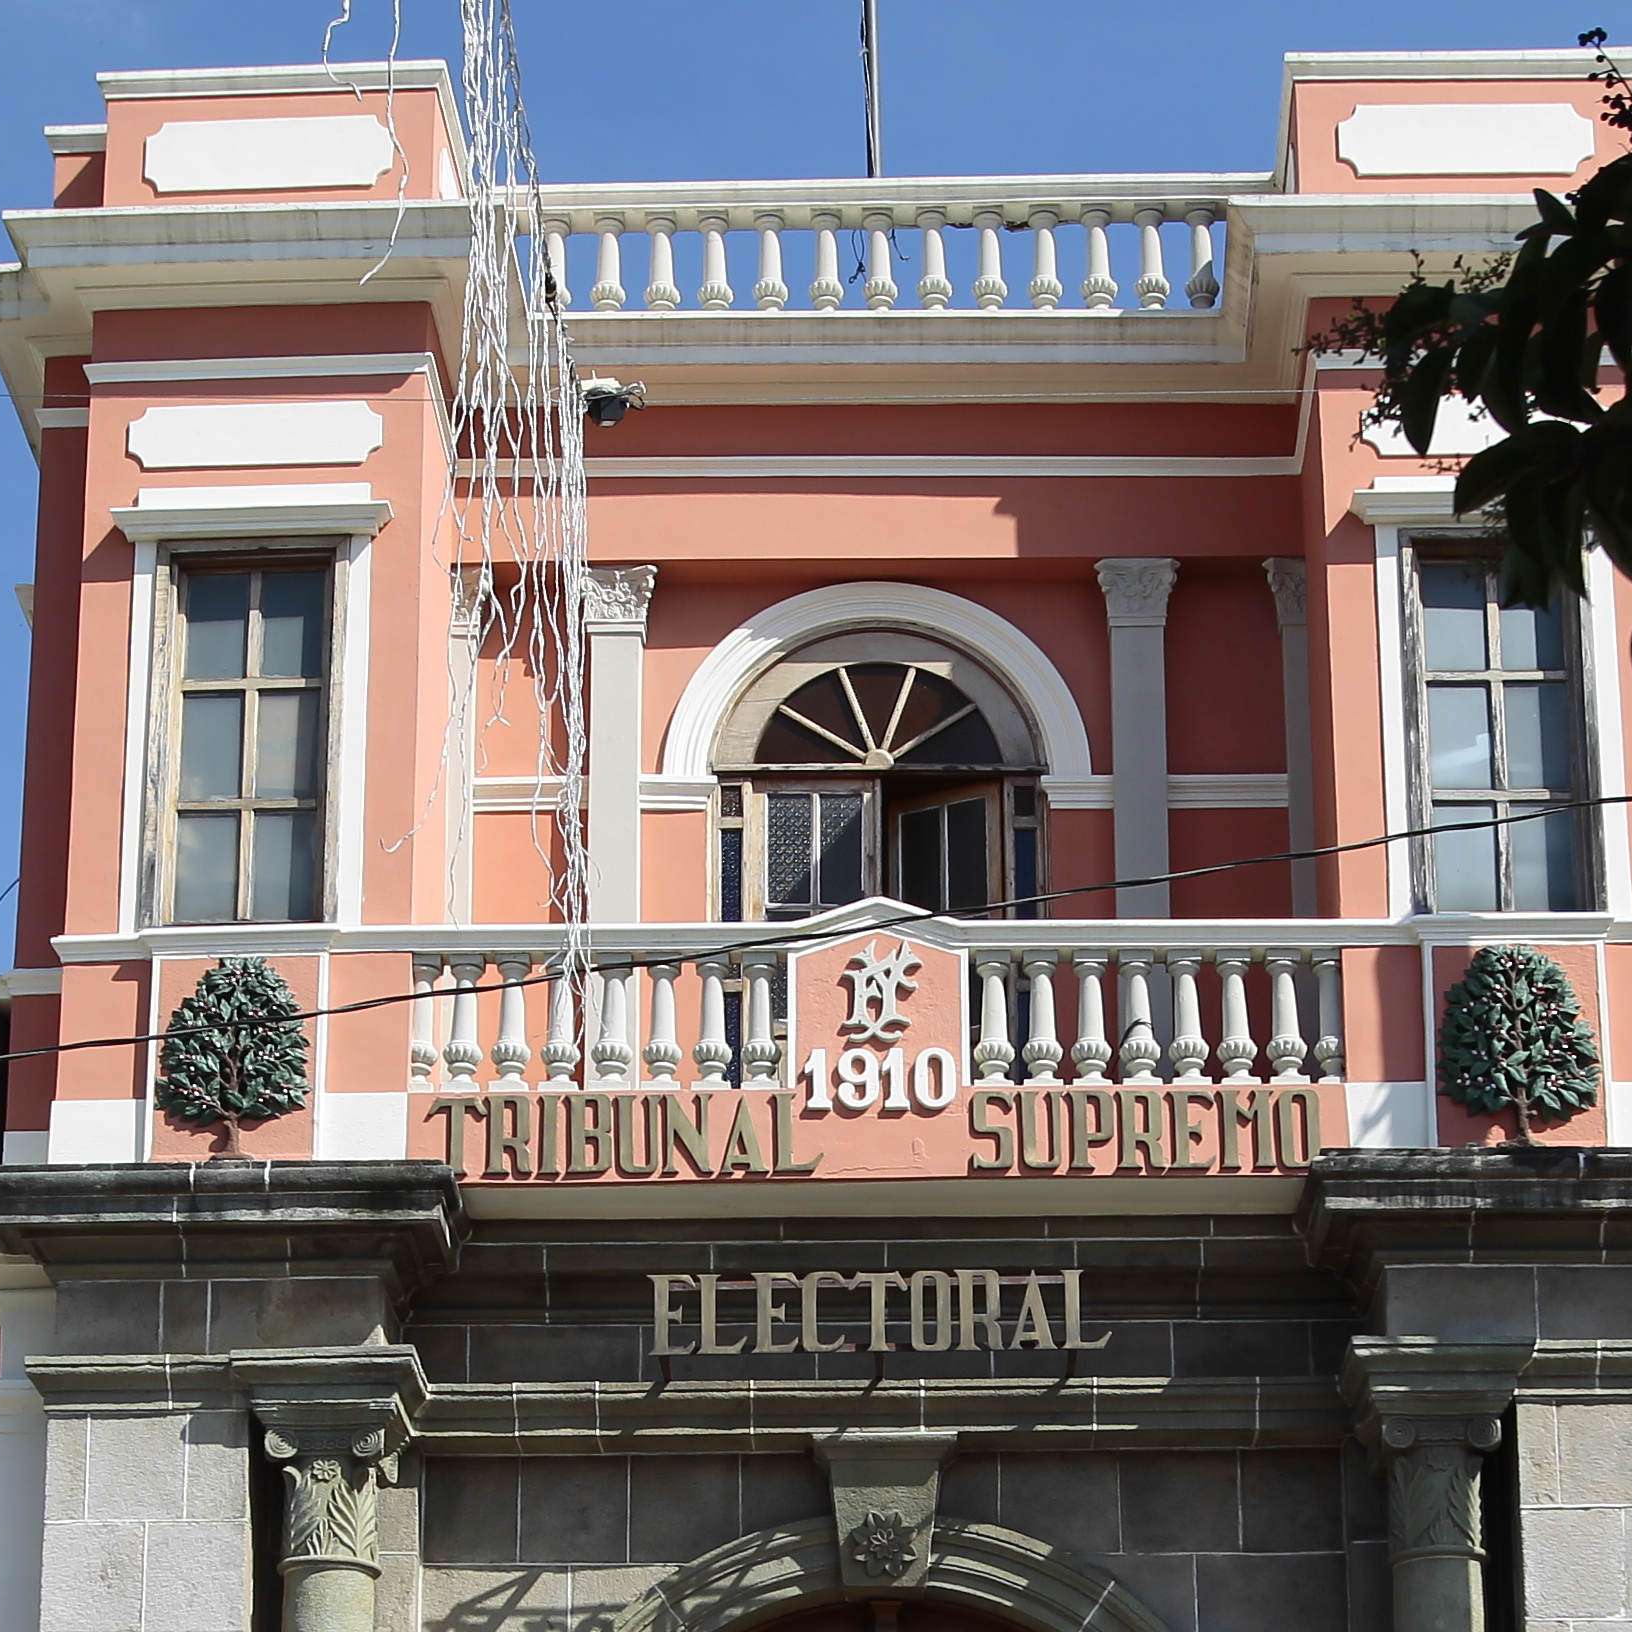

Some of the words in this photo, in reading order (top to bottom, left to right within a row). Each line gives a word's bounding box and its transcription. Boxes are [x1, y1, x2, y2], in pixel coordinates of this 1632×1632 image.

[805, 1047, 957, 1110] 1910
[426, 1091, 824, 1178] TRIBUNAL
[970, 1087, 1321, 1171] SUPREMO
[647, 1268, 1114, 1355] ELECTORAL
